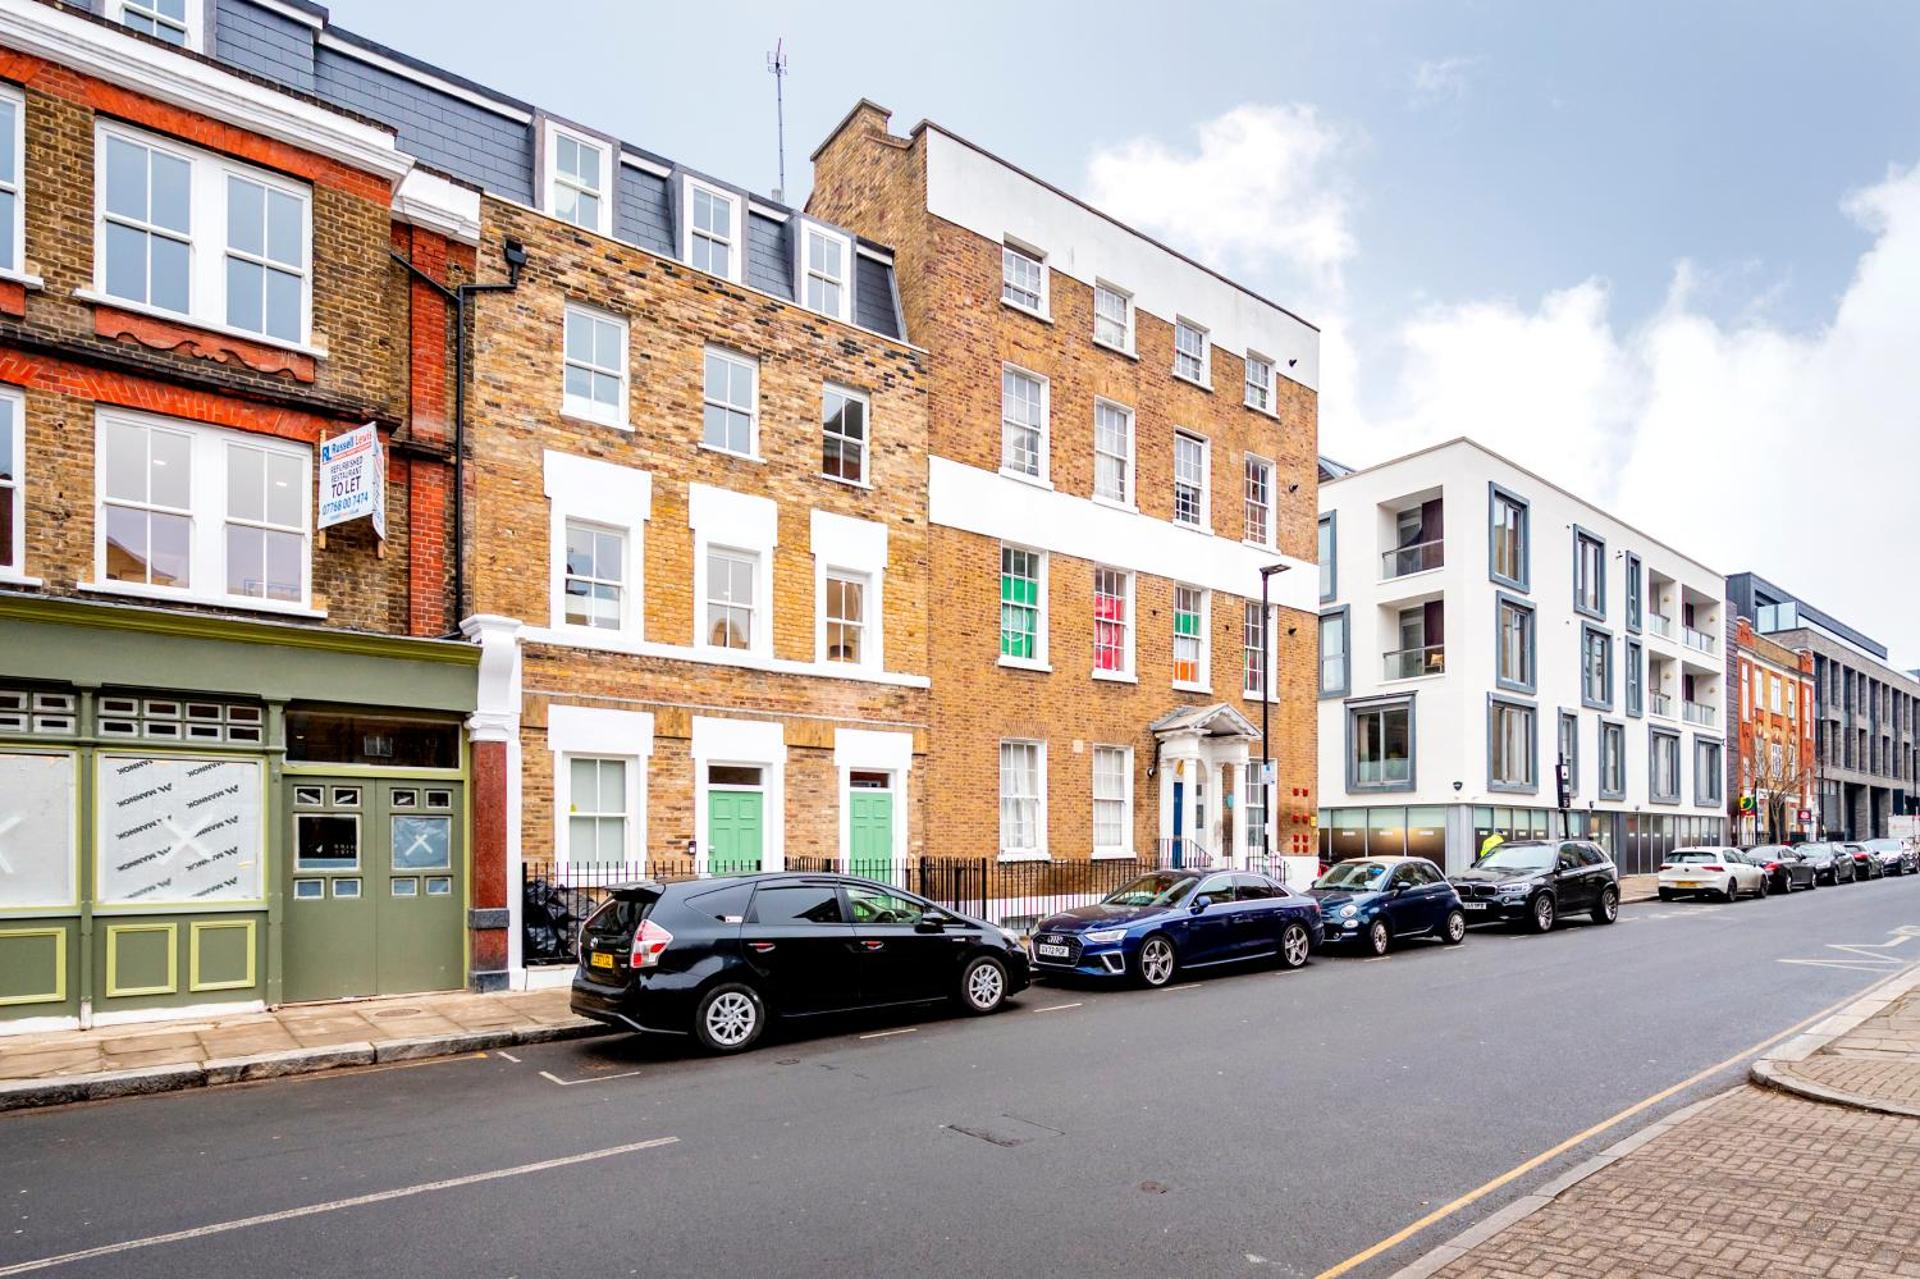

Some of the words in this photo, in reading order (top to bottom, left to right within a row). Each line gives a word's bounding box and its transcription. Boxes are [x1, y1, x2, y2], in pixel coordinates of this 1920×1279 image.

[332, 436, 353, 453] Russell
[331, 466, 362, 483] RESTAURANT
[331, 481, 344, 498] TO
[345, 475, 362, 495] LET
[116, 789, 157, 807] MANNOK
[186, 790, 224, 808] MANNOK
[116, 821, 157, 840] MANNOK
[116, 853, 157, 871] MANNOK
